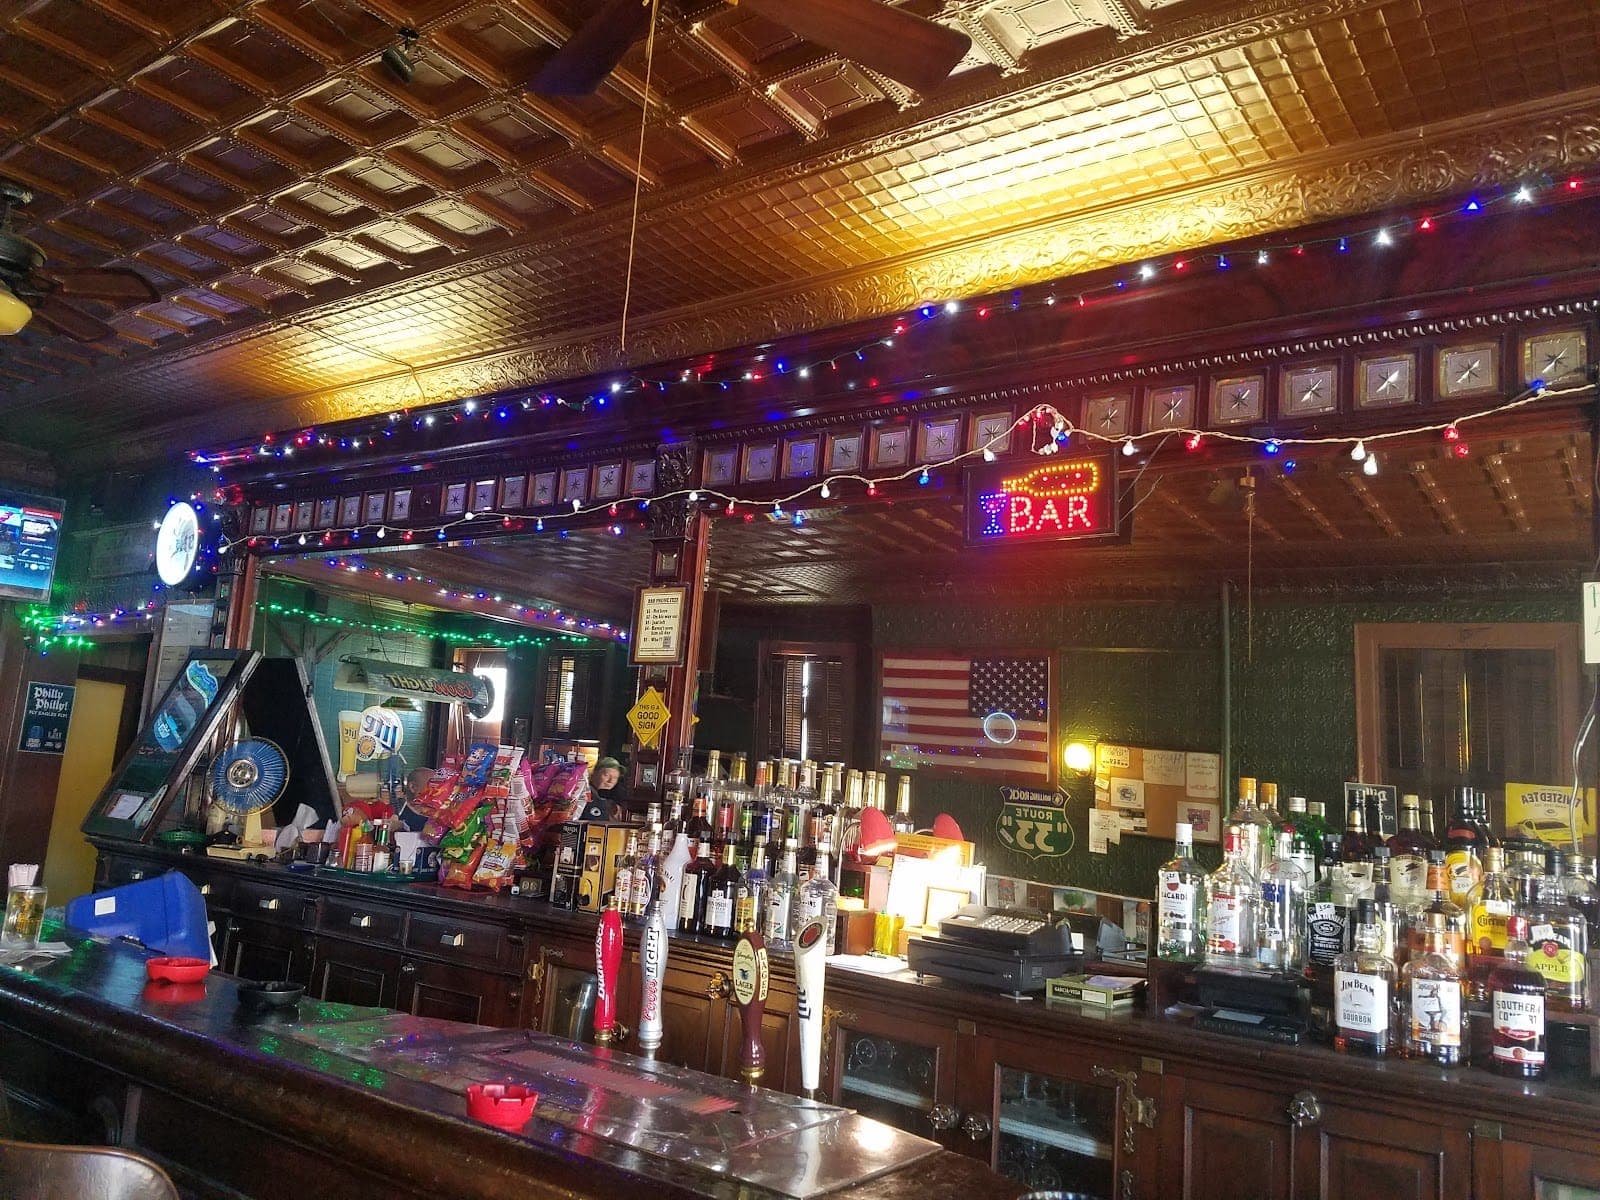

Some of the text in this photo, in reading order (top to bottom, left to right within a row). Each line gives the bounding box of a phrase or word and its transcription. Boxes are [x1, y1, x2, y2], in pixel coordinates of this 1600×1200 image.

[1009, 495, 1092, 533] BAR
[33, 686, 64, 701] Philly
[35, 698, 69, 712] Philly!
[637, 711, 660, 720] GOOD
[638, 720, 657, 730] SIGN
[1161, 892, 1188, 901] ACARDI
[642, 926, 660, 1022] Coors LIGHT
[760, 951, 768, 998] LAGER
[1535, 963, 1569, 973] APPLE
[735, 979, 754, 990] LAGER
[1341, 979, 1375, 997] JIM BEAM
[1343, 1011, 1372, 1025] BOURBON
[1498, 1010, 1538, 1025] CORT
